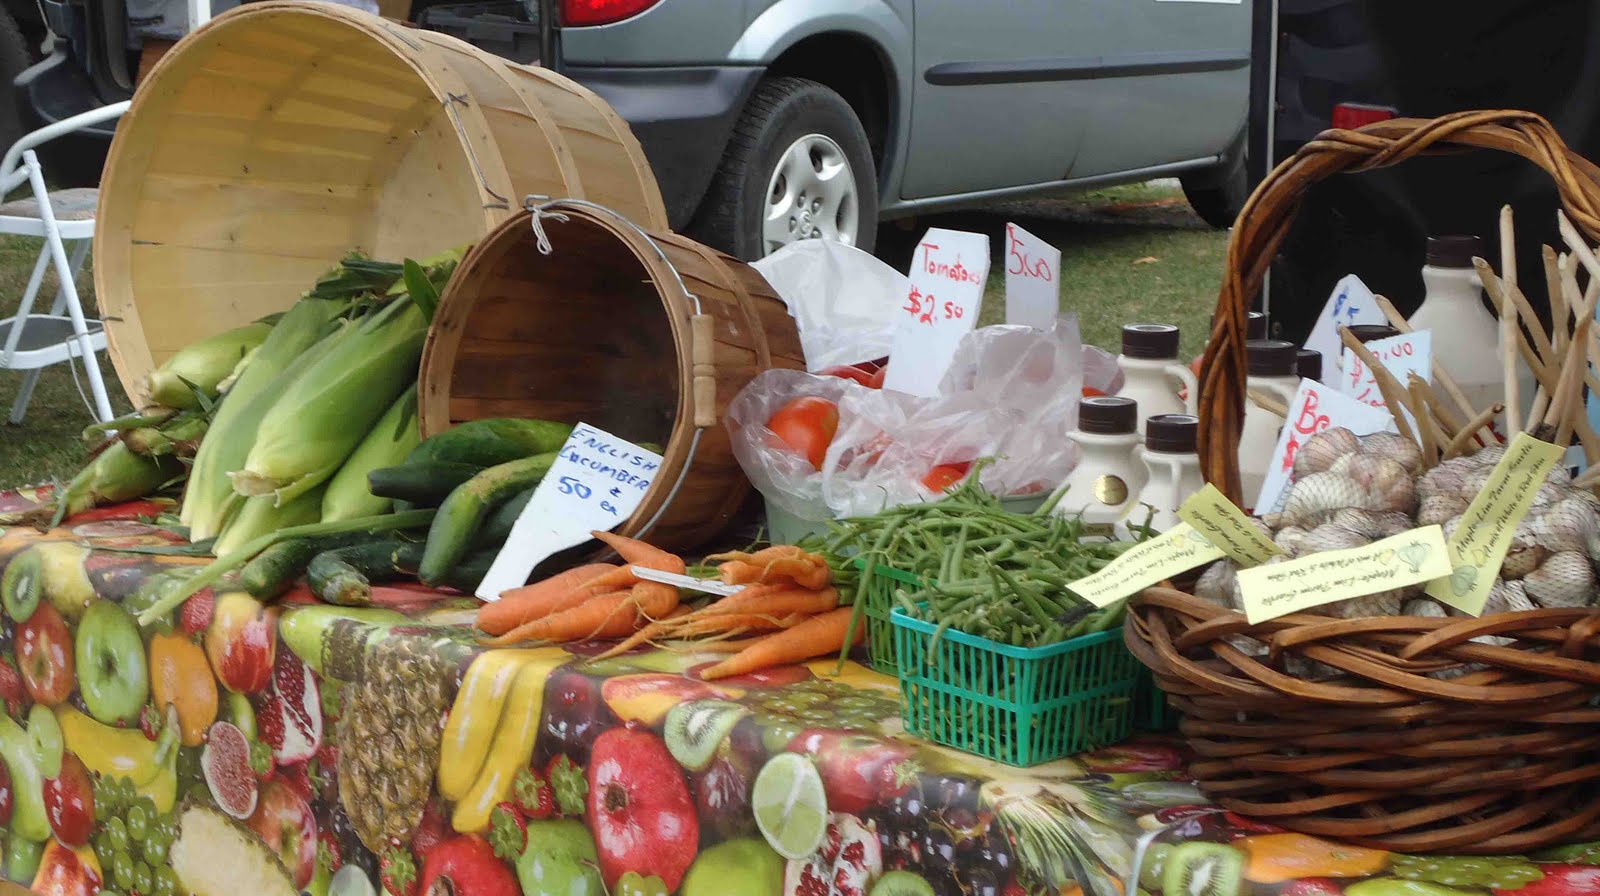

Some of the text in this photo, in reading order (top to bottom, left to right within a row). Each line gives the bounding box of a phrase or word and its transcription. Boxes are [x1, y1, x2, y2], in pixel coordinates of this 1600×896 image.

[921, 243, 981, 286] Tomatoes
[559, 445, 651, 491] CUCUMBER
[571, 428, 657, 471] ENGLISH
[558, 475, 592, 500] 50
[1488, 473, 1511, 501] Farm
[1508, 444, 1533, 472] Garlic
[1191, 510, 1224, 534] Garlic
[1489, 533, 1499, 547] mix
[1530, 458, 1545, 474] Skin
[1221, 531, 1246, 555] Farm
[1261, 590, 1297, 606] Garlic
